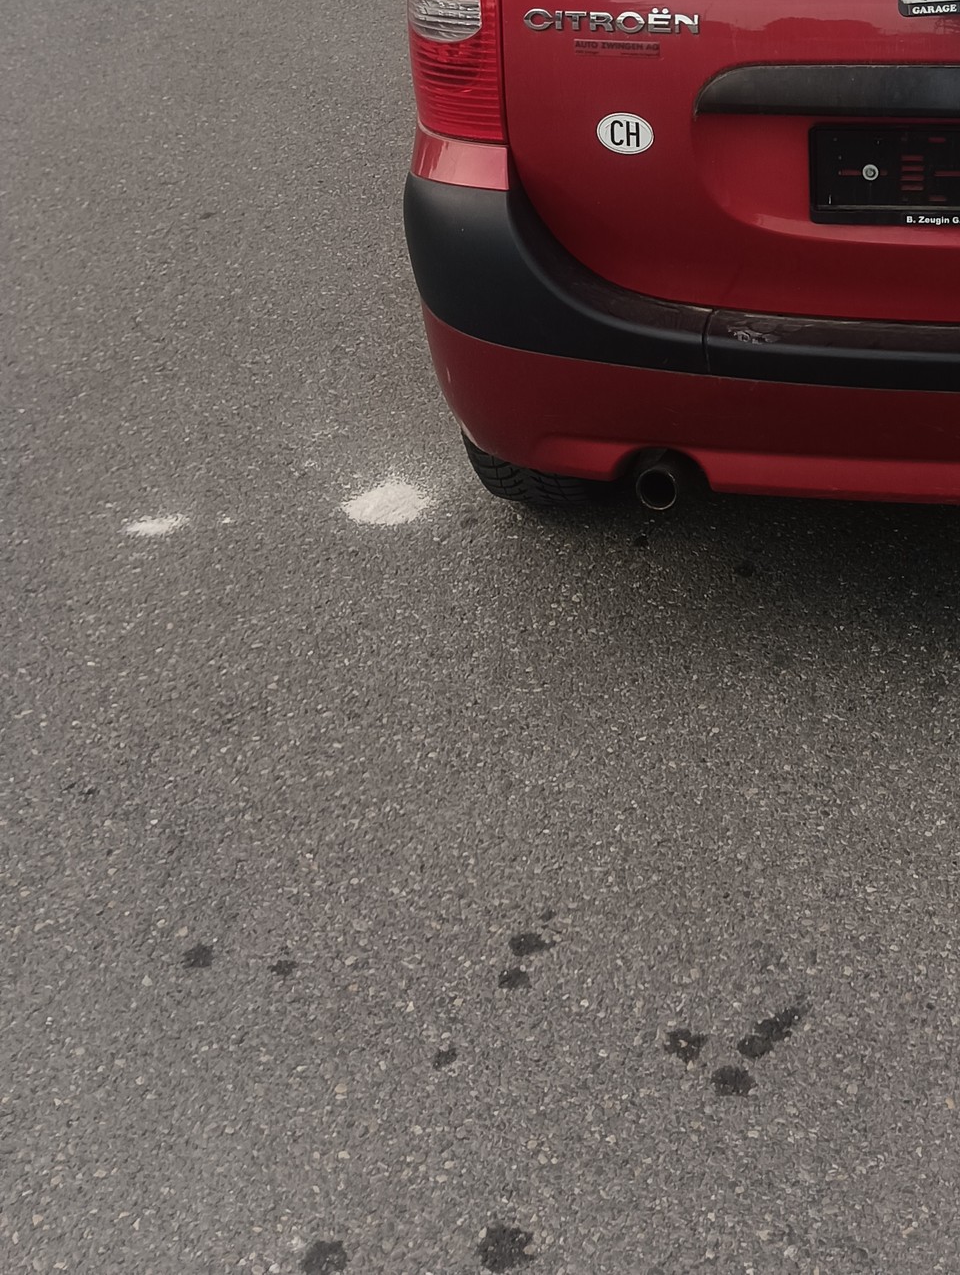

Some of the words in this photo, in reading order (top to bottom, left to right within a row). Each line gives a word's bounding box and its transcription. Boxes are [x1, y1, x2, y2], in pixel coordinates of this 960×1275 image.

[912, 3, 957, 15] GARAGE
[523, 7, 700, 34] CITROËN
[610, 120, 640, 148] CH
[906, 215, 917, 224] B.
[918, 215, 950, 226] Zeugin
